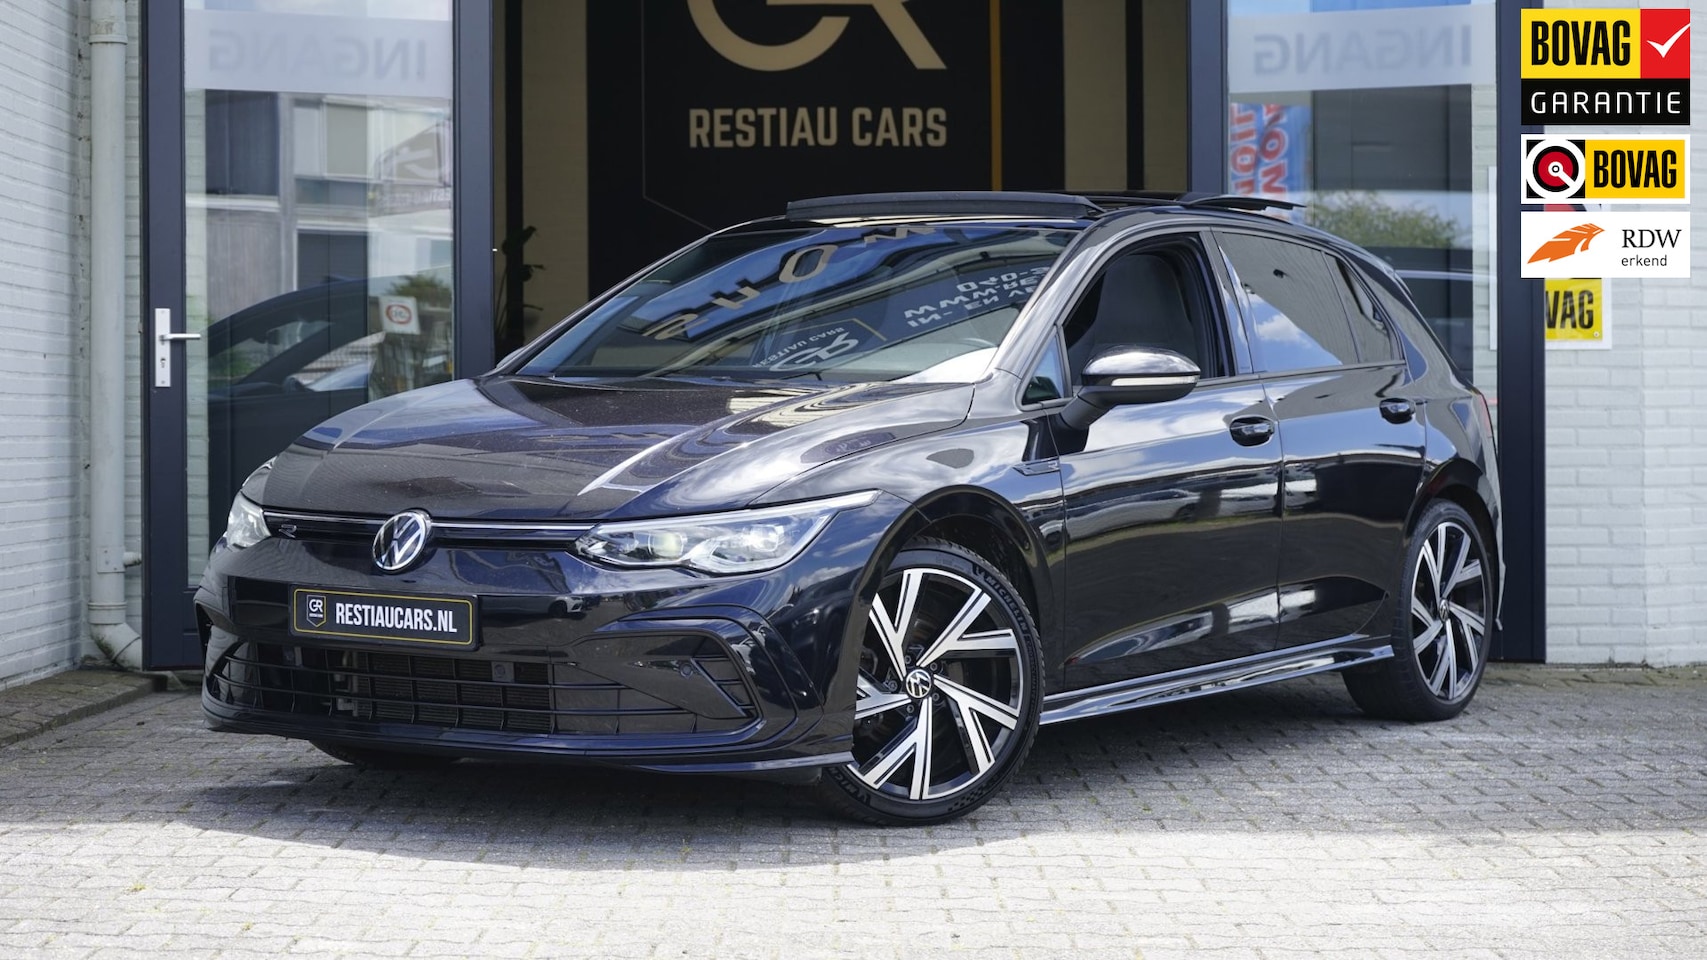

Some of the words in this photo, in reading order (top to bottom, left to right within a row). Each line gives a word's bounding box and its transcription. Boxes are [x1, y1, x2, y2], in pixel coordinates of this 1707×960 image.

[689, 107, 838, 148] RESTIAU
[852, 107, 947, 147] CARS
[335, 602, 458, 633] RESTIAUCARS.NL
[985, 574, 1028, 631] MICHELIN
